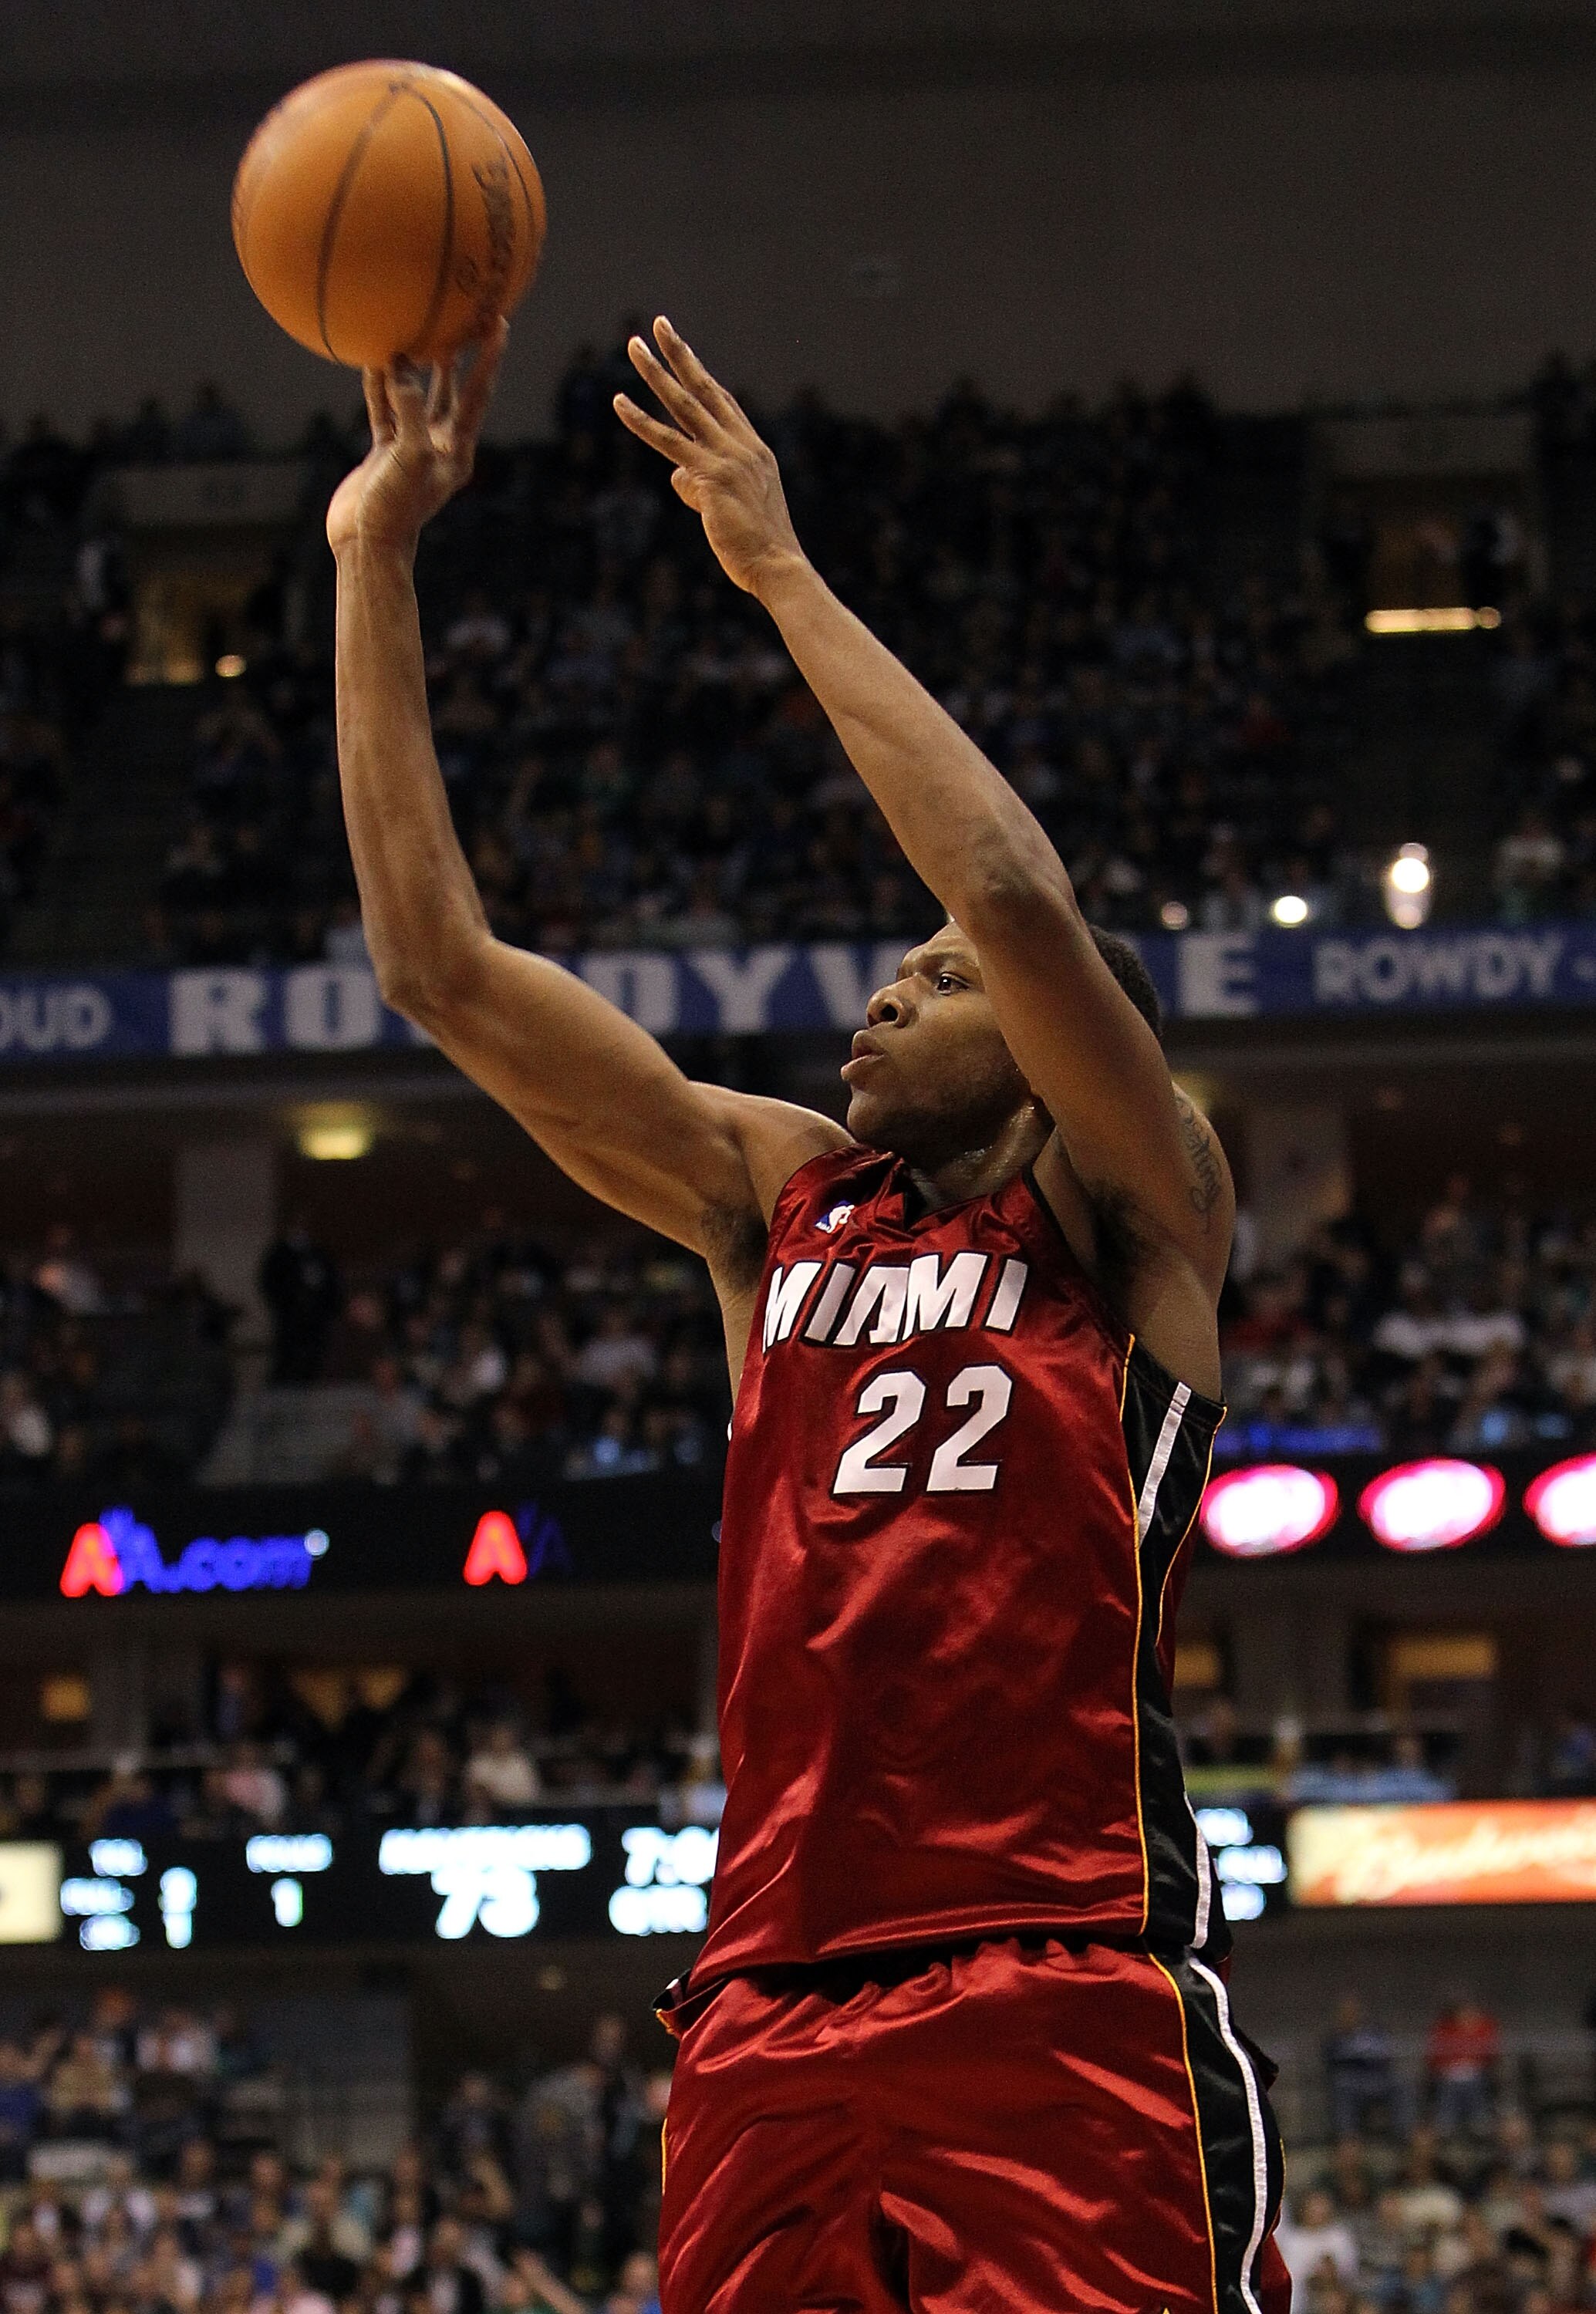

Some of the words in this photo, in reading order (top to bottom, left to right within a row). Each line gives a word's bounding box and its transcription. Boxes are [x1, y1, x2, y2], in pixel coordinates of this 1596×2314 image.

[1315, 934, 1563, 1000] ROWDY
[764, 1254, 1029, 1353] MIAMI
[834, 1365, 1012, 1494] 22
